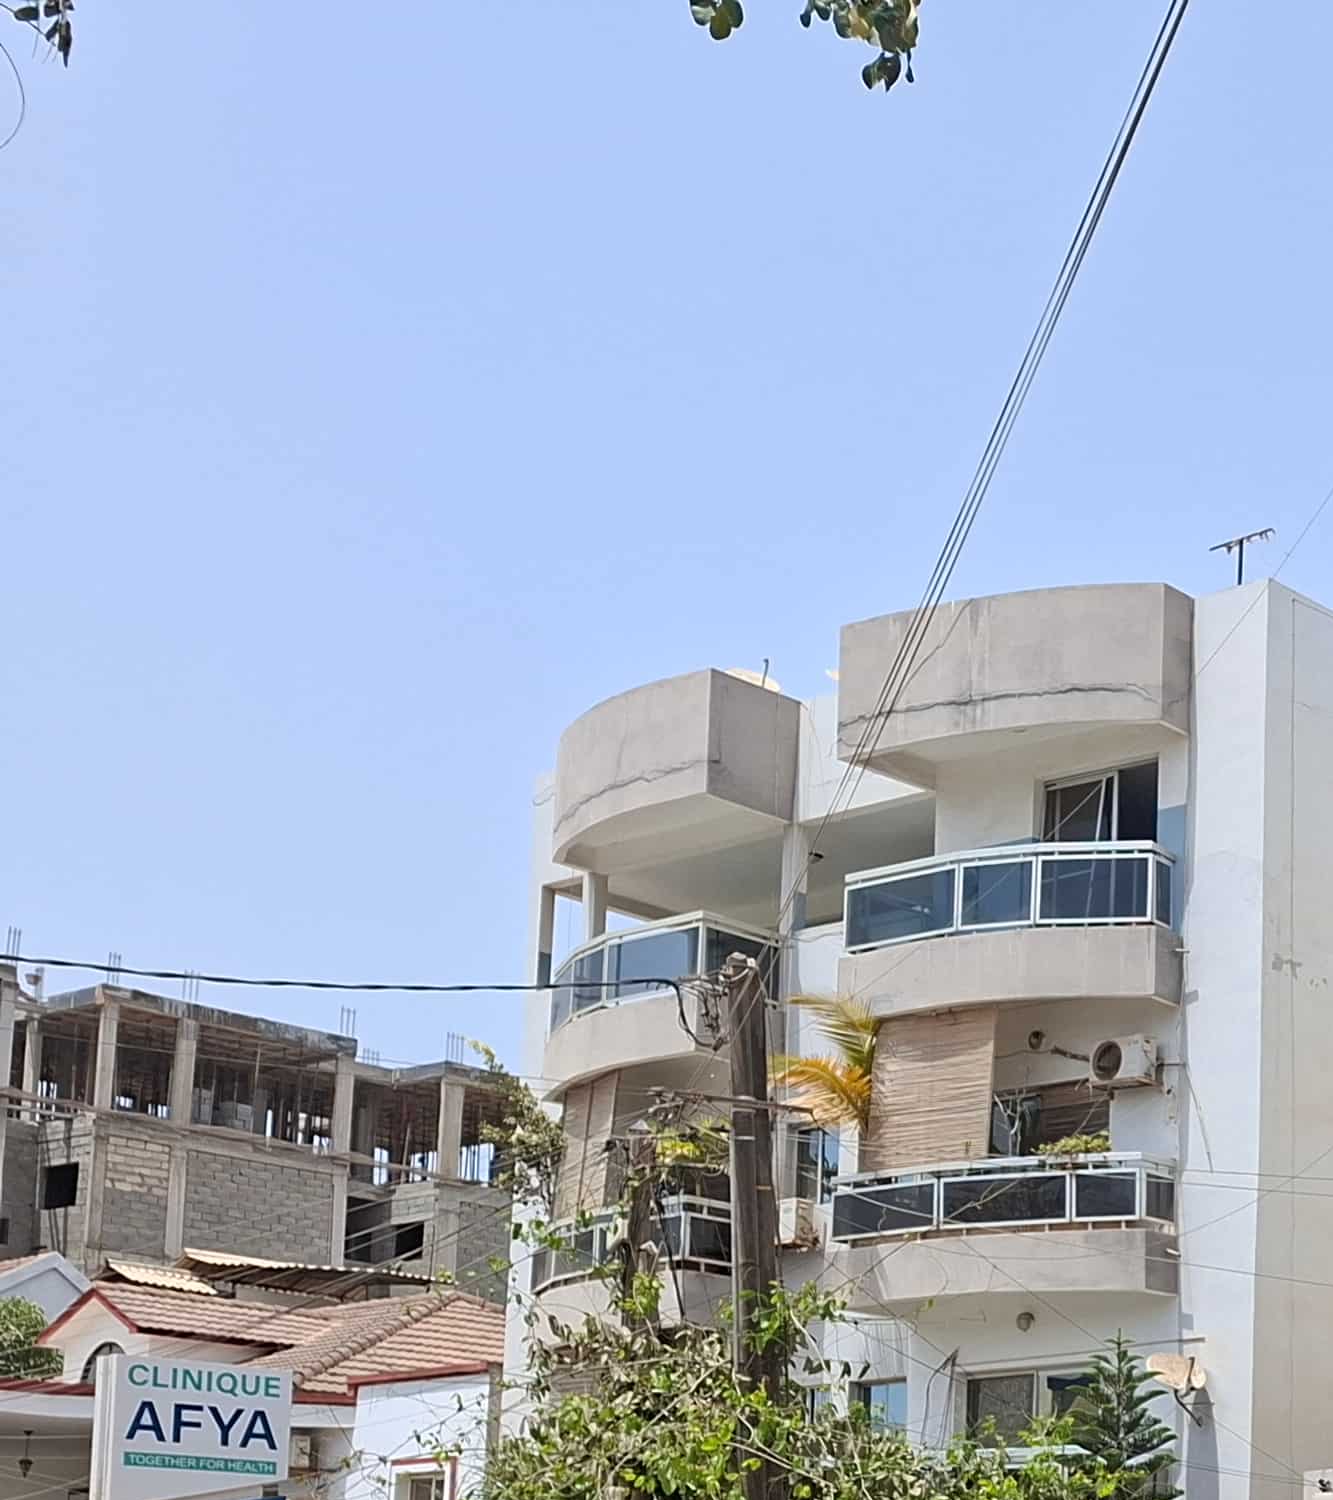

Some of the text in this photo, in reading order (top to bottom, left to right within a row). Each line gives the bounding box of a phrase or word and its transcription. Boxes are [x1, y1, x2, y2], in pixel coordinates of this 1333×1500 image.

[127, 1364, 281, 1398] CLINIQUE
[125, 1400, 278, 1450] AFYA
[129, 1454, 274, 1473] TOGETHER FOR HEALTH
